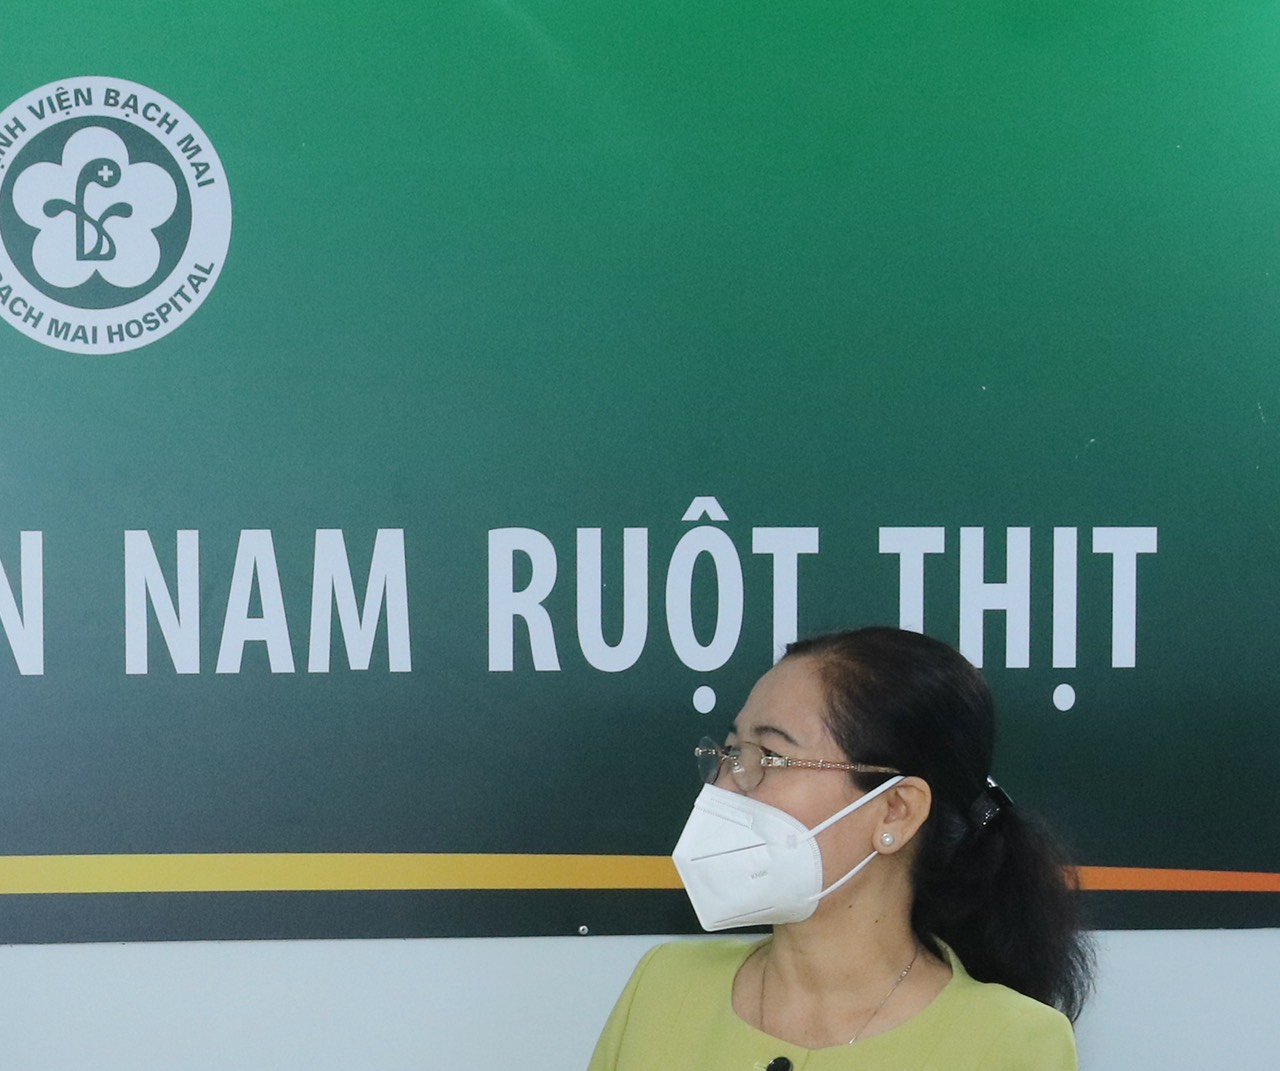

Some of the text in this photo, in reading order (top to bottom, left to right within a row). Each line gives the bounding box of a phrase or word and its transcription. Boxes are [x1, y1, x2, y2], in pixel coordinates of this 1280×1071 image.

[27, 86, 93, 121] VIỆN
[103, 88, 180, 135] BẠCH
[176, 133, 215, 188] MAI
[46, 318, 98, 344] MAI
[107, 262, 214, 343] HOSPITAL
[124, 528, 412, 675] NAM
[488, 496, 819, 714] RUỘT
[878, 526, 1158, 711] THỊT
